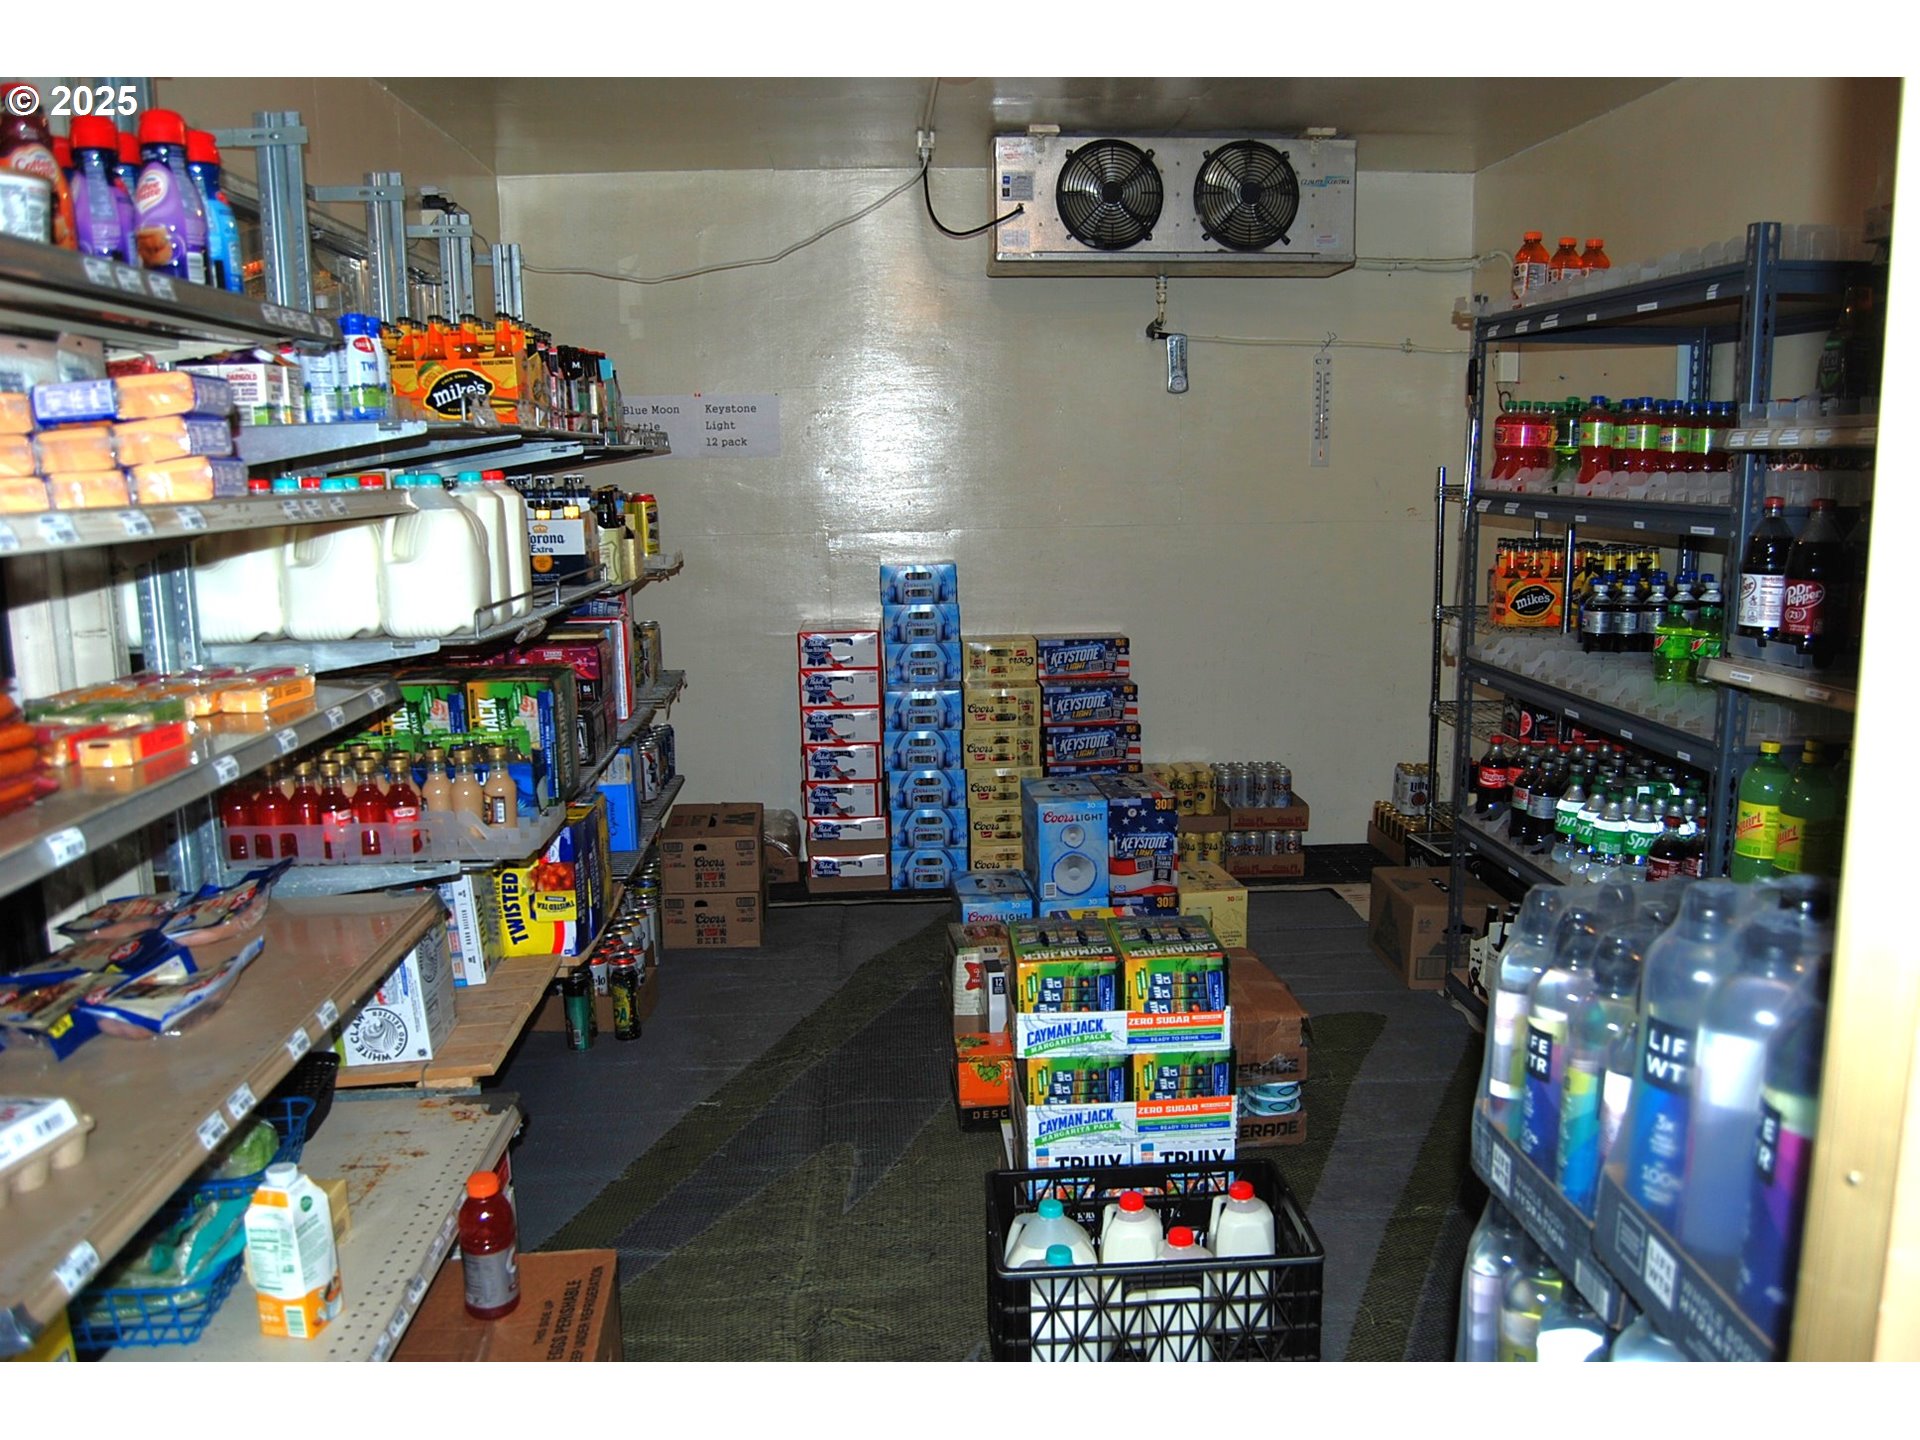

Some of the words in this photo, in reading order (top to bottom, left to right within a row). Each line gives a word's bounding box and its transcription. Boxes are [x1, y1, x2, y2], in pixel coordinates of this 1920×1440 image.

[433, 380, 486, 407] mike's
[623, 406, 648, 415] Blue
[651, 406, 680, 414] Moon
[705, 404, 757, 415] Keystone
[705, 421, 736, 431] Light
[706, 438, 718, 447] 12
[722, 438, 748, 448] pack
[531, 545, 554, 553] Extra
[1796, 584, 1812, 595] Dr
[1516, 593, 1551, 610] mike's
[1787, 586, 1822, 606] Pepper
[1051, 647, 1098, 667] KEYSTONE
[967, 704, 994, 713] Coors
[1056, 694, 1106, 715] KEYSTONE
[967, 743, 993, 753] Coors
[1060, 735, 1110, 754] KEYSTONE
[971, 782, 997, 792] Coors
[1155, 799, 1167, 810] 30
[1043, 811, 1074, 824] Coors
[1076, 813, 1103, 822] LIGHT
[974, 822, 999, 830] Coors
[1120, 835, 1169, 851] KEYSTONE
[694, 857, 725, 867] Coors
[974, 861, 1000, 869] Coors
[1157, 897, 1169, 908] 30
[502, 873, 529, 945] TWISTED
[695, 913, 726, 924] Coors
[968, 912, 998, 922] Coors
[1001, 913, 1027, 922] LIGHT
[1061, 946, 1113, 957] CAYMAN
[1129, 947, 1167, 957] JACK
[1167, 942, 1218, 952] CAYMAN
[1023, 951, 1059, 960] JACK
[995, 978, 1003, 987] 12
[1128, 1017, 1154, 1026] ZERO
[1156, 1016, 1190, 1025] SUGAR
[350, 1012, 365, 1044] CLAW
[1027, 1021, 1070, 1046] CAYMAN
[1070, 1018, 1104, 1035] JACK
[1031, 1034, 1081, 1053] MARGARITA
[1084, 1033, 1108, 1042] PACK
[356, 1046, 392, 1061] WHITE
[1138, 1106, 1162, 1115] ZERO
[1165, 1104, 1198, 1113] SUGAR
[1038, 1112, 1084, 1135] CAYMAN
[1083, 1108, 1114, 1123] JACK
[1041, 1125, 1090, 1142] MARGARITA
[554, 1280, 582, 1333] PERISHABLE
